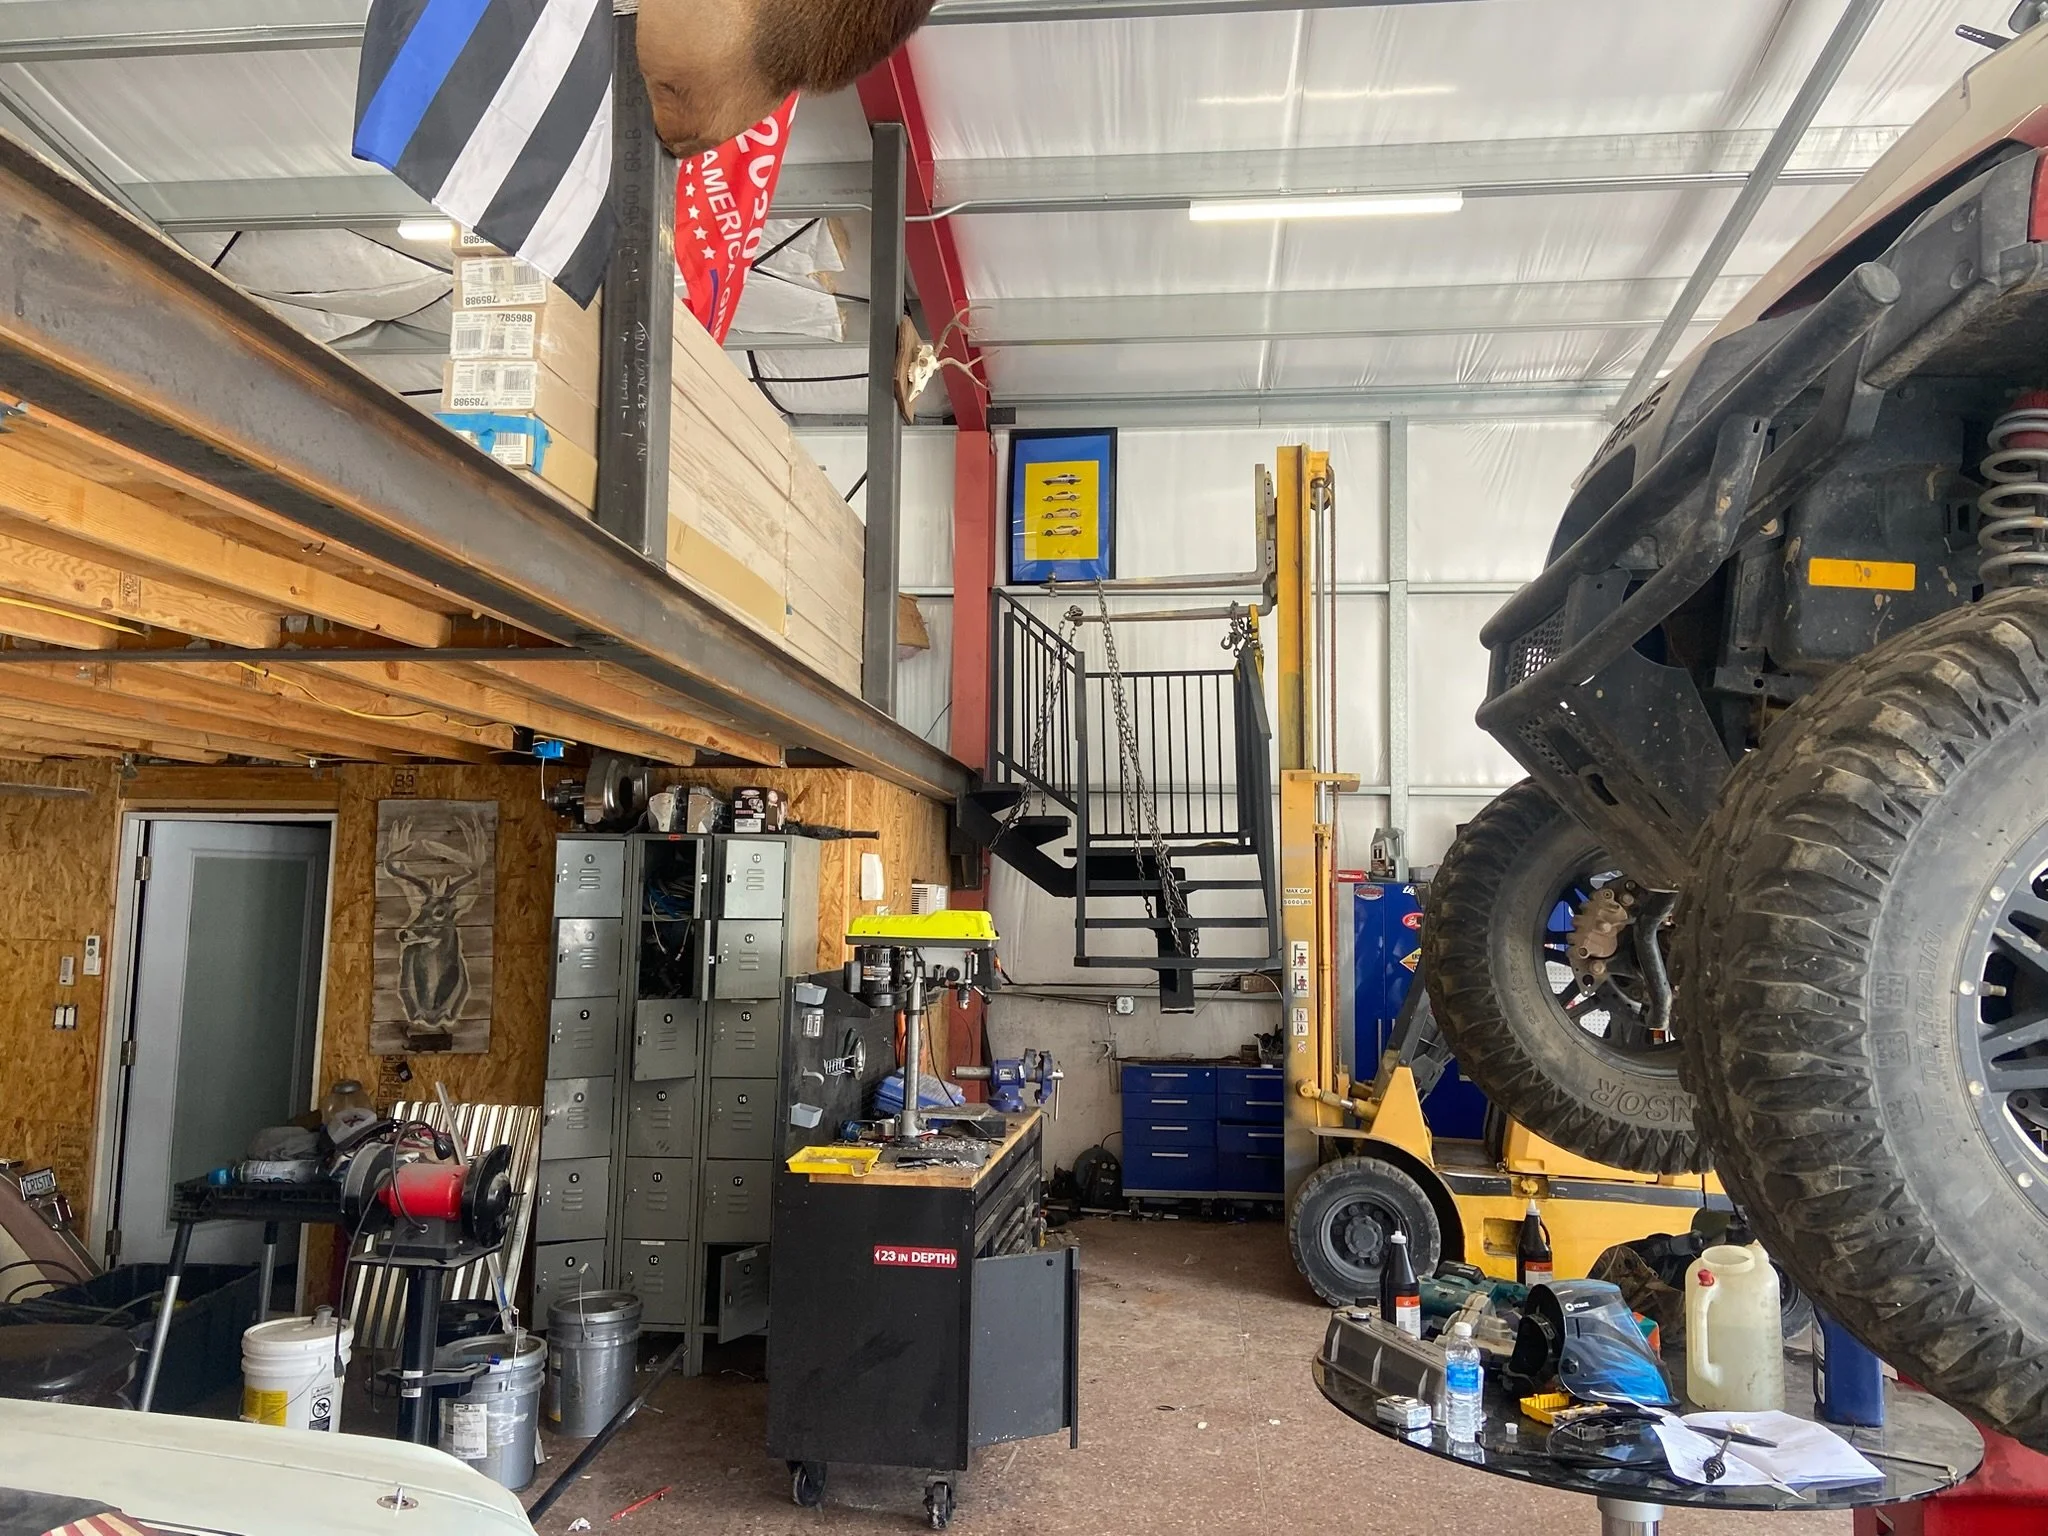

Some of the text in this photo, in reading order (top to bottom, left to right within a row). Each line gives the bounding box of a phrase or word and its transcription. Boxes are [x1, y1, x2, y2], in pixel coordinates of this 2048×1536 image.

[700, 149, 743, 284] AMERICA
[1915, 927, 1943, 1086] TERRAIN
[1590, 1078, 1694, 1122] NSOR
[881, 1250, 951, 1264] 23 IN DEPTH
